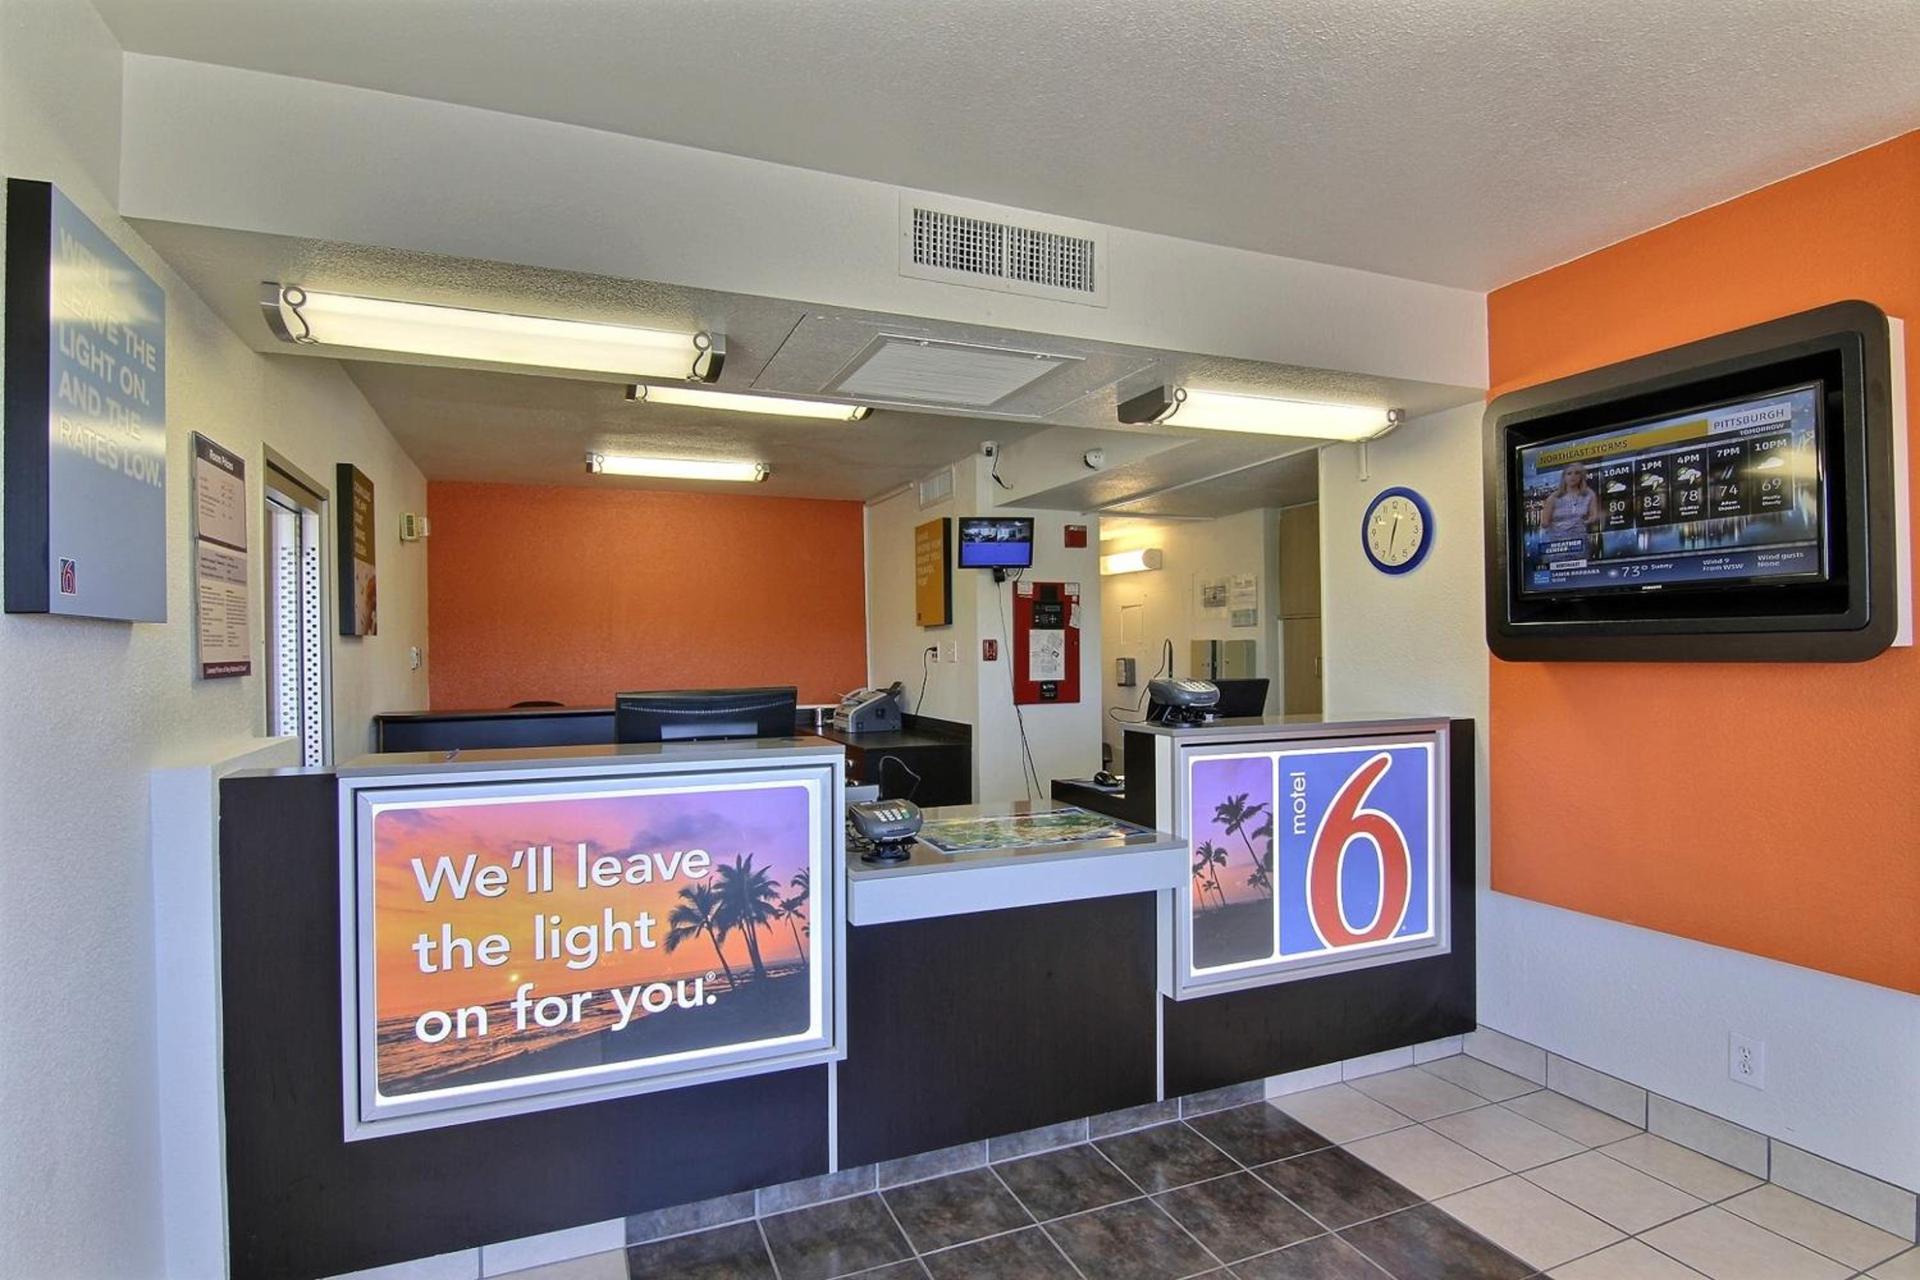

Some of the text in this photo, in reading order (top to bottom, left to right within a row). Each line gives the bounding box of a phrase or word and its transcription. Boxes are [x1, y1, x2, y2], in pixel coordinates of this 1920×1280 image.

[123, 325, 156, 372] THE
[60, 320, 150, 406] LIGHT ON.
[59, 380, 143, 441] AND THE
[1713, 408, 1785, 430] PITTSBURGH
[1739, 422, 1785, 436] TOMORROW
[1539, 440, 1628, 464] NORTHEAST STORMS
[1754, 438, 1788, 452] 10PM
[59, 417, 162, 488] RATES LOW.
[1677, 453, 1700, 465] 4PM
[1716, 447, 1741, 458] 7PM
[1604, 466, 1630, 478] 10AM
[1641, 460, 1662, 471] 1PM
[1719, 484, 1739, 497] 74
[1762, 479, 1782, 492] 69
[1643, 495, 1661, 508] 82
[1680, 490, 1699, 503] 78
[1609, 501, 1626, 513] 80
[1757, 553, 1780, 562] Wind
[1290, 751, 1412, 950] motel 6
[410, 841, 712, 903] We'll leave
[411, 906, 657, 975] the light
[414, 1004, 489, 1044] on
[510, 981, 596, 1032] for
